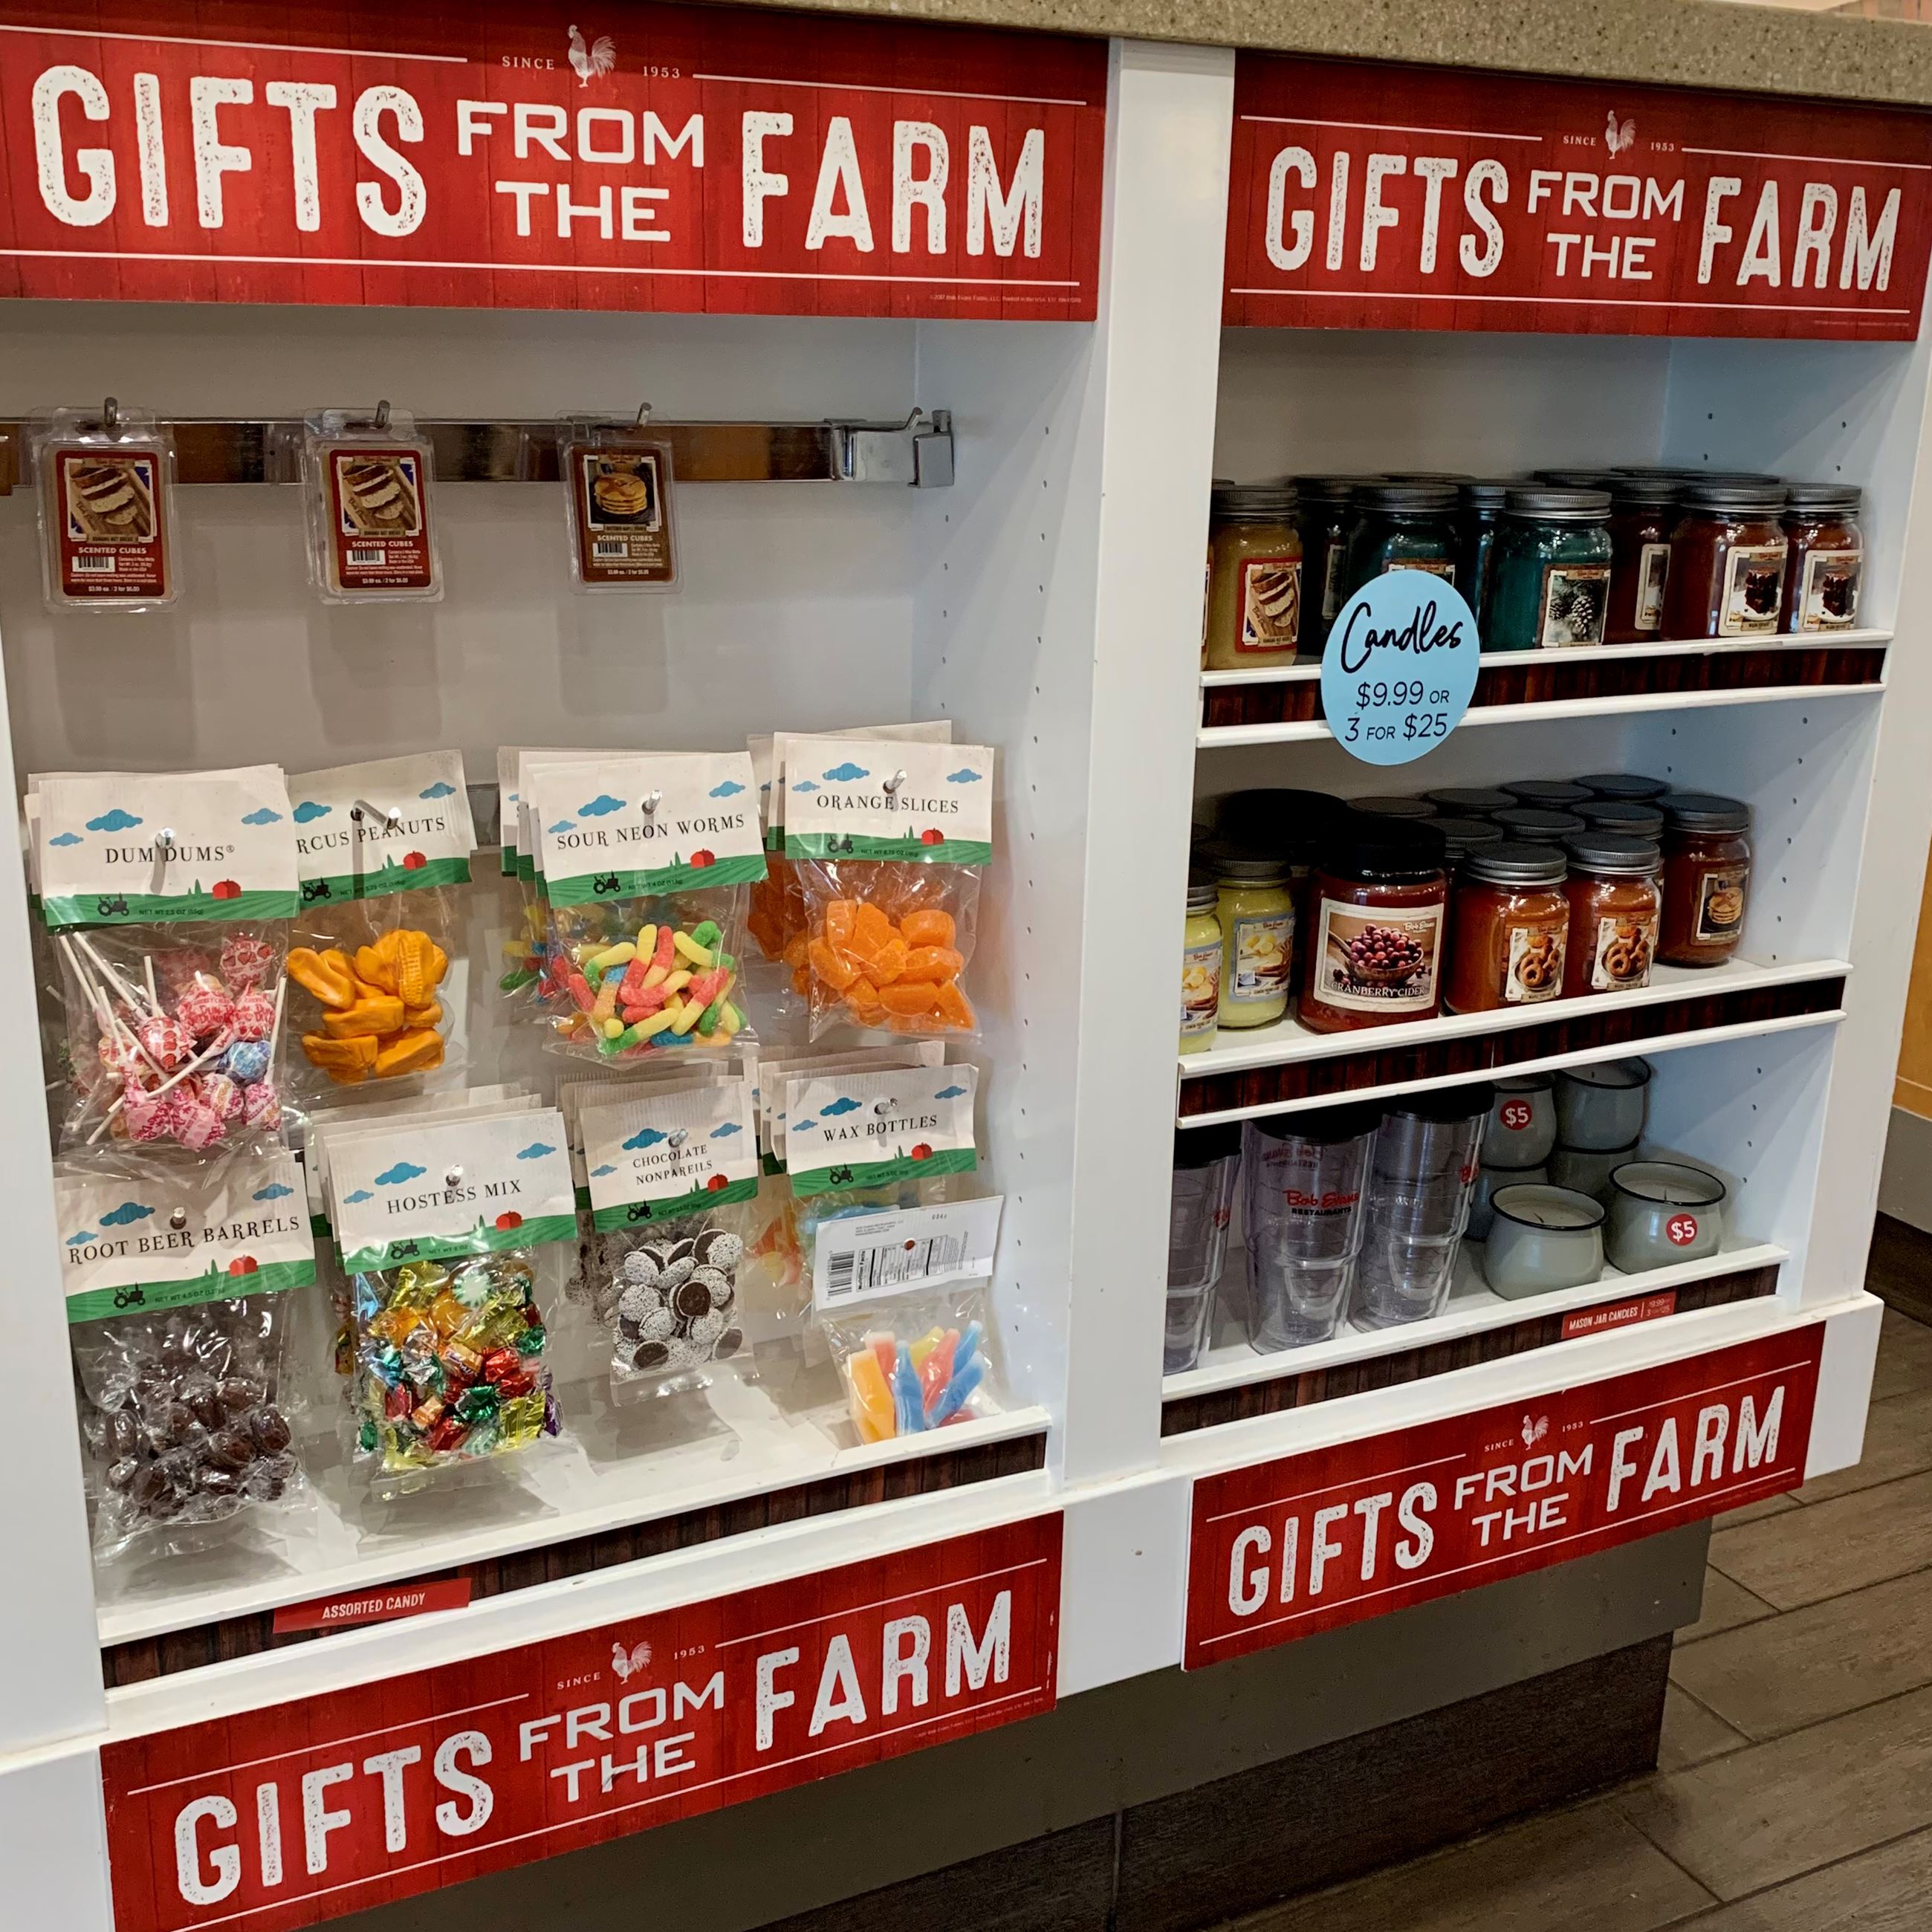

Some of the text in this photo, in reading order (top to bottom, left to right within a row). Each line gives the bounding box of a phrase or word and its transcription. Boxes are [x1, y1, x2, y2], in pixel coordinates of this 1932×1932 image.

[501, 55, 681, 80] SINCE 1953
[1563, 134, 1676, 152] SINCE 1953
[31, 65, 1046, 259] GIFTS FROM THE FARM
[1265, 146, 1902, 291] GIFTS FROM THE FARM
[1341, 600, 1464, 674] Candles
[1355, 680, 1450, 711] $9.99 OR
[1344, 713, 1448, 742] 3 FOR $25
[817, 794, 959, 814] ORANGE SLICES
[296, 817, 446, 855] RCUS PEANUTS
[557, 814, 745, 850] SOUR NEON WORMS
[104, 847, 154, 864] DUM
[1331, 982, 1425, 997] CRANBERRY CIDER
[823, 1114, 939, 1142] WAX BOTTLES
[1505, 1106, 1529, 1126] $5
[632, 1144, 708, 1169] CHOCOLATE
[635, 1159, 713, 1185] NONPAREILS
[386, 1179, 523, 1215] HOSTESS MIX
[1282, 1188, 1361, 1208] Bob Evans
[1291, 1206, 1352, 1216] RESTAURANTS
[68, 1216, 300, 1265] ROOT BEER BARRELS
[1670, 1220, 1696, 1242] $5
[1568, 1306, 1638, 1331] MASON JAR CANDLES
[1484, 1420, 1584, 1453] SINCE 1953
[1228, 1384, 1786, 1618] GIFTS FROM THE FARM
[322, 1592, 427, 1621] ASSORTED CANDY
[557, 1644, 707, 1690] SINCE 1953
[174, 1589, 1012, 1906] GIFTS FROM THE FARM
